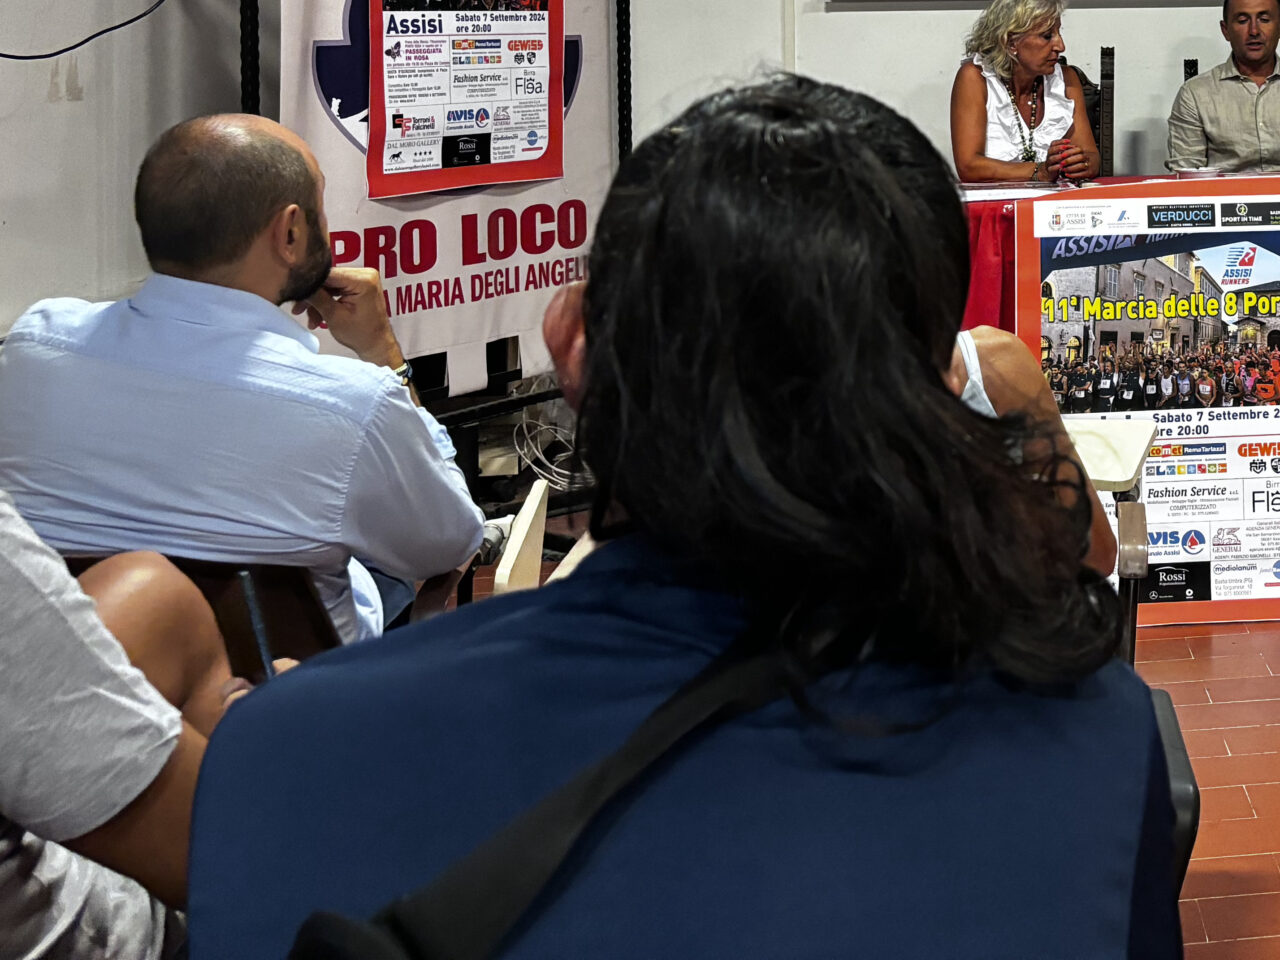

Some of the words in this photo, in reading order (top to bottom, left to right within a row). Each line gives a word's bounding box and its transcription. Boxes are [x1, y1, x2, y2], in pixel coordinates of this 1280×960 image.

[456, 14, 480, 22] Sabato
[484, 14, 488, 22] 7
[490, 14, 527, 22] Settembre
[529, 14, 545, 22] 2024
[386, 14, 443, 34] Assisi
[471, 24, 491, 32] 20:00
[454, 74, 478, 83] Fashion
[481, 74, 501, 82] Service
[447, 110, 474, 121] AVIS
[459, 142, 476, 150] Rossi
[1152, 211, 1212, 221] VERDUCCI
[329, 219, 437, 279] PRO
[461, 199, 587, 266] LOCO
[1223, 269, 1252, 277] ASSISI
[397, 277, 465, 316] MARIA
[471, 266, 520, 302] DEGLI
[1083, 295, 1158, 321] Marcia
[1164, 293, 1219, 318] delle
[1224, 295, 1237, 316] 8
[1153, 413, 1192, 423] Sabato
[1197, 412, 1203, 421] 7
[1208, 409, 1269, 421] Settembre
[1178, 425, 1209, 435] 20:00
[1148, 487, 1187, 498] Fashion
[1191, 486, 1226, 496] Service
[1159, 571, 1185, 581] Rossi
